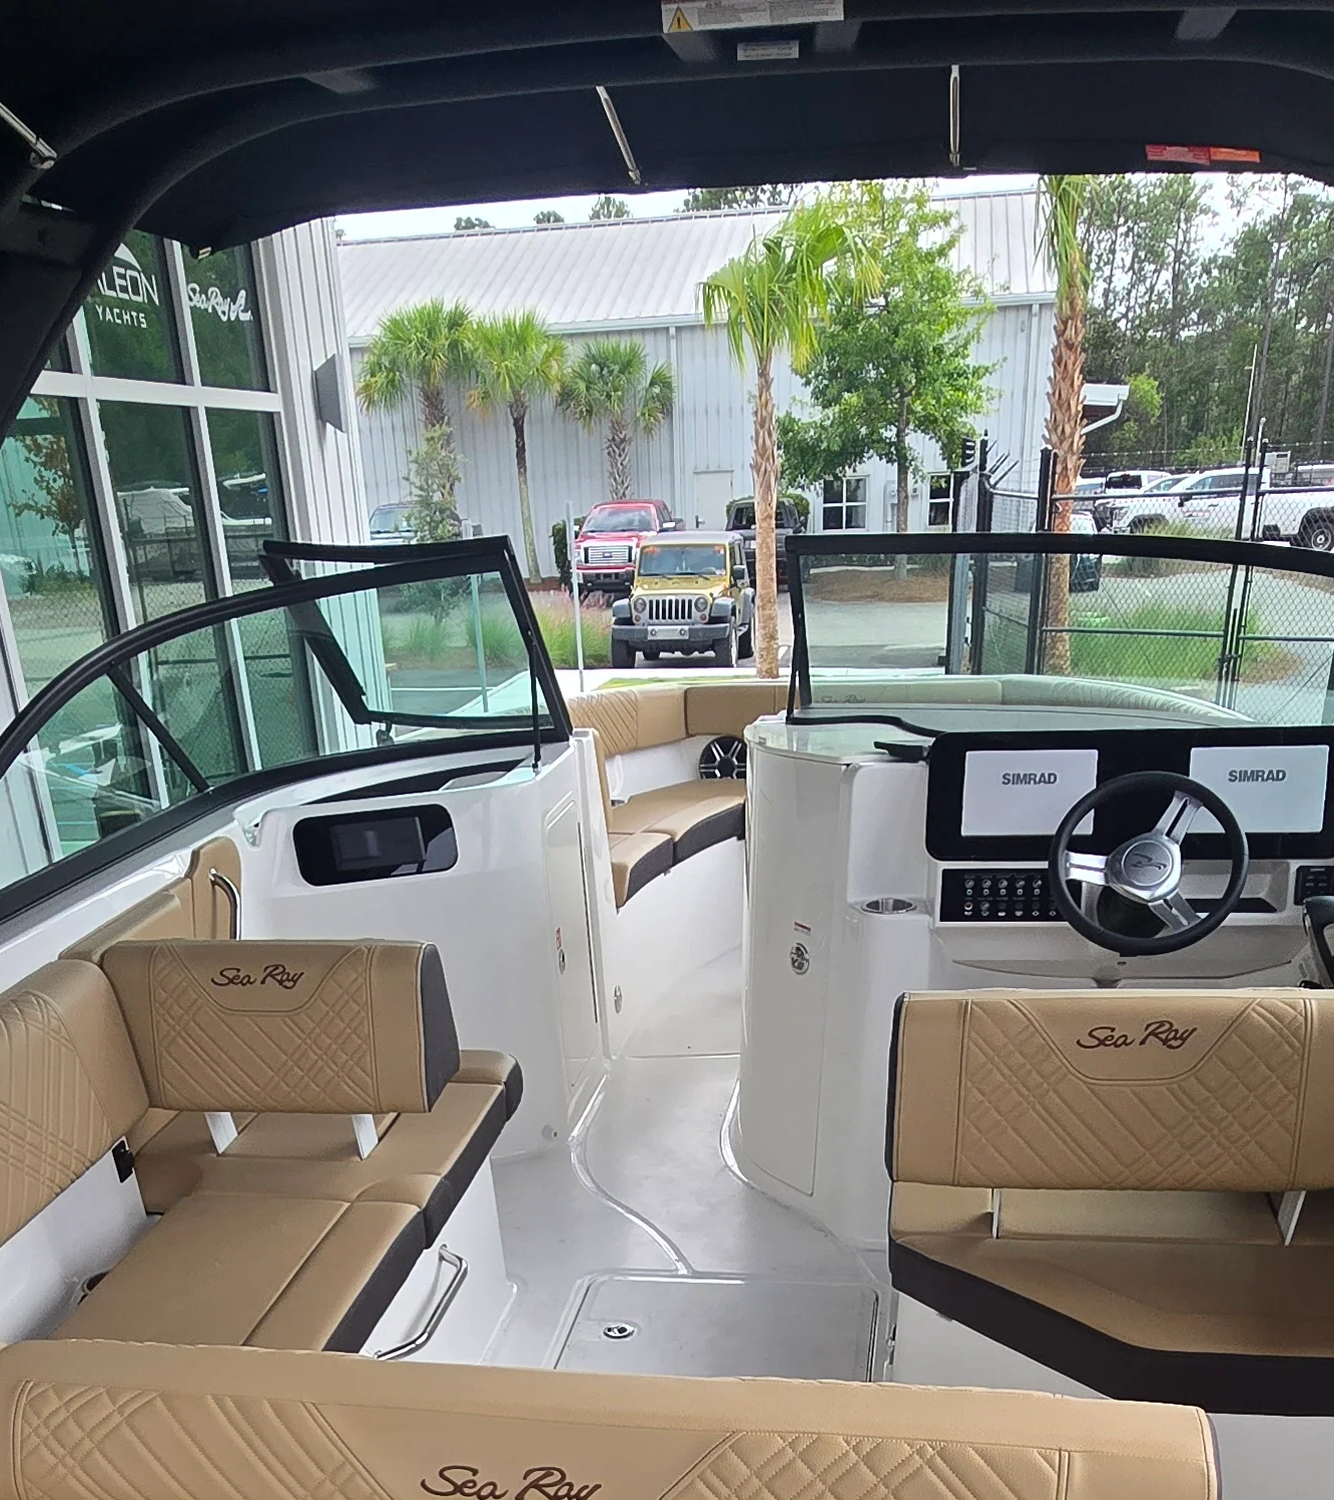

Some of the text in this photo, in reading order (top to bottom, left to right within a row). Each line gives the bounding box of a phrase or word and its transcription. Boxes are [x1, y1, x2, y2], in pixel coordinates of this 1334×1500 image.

[95, 304, 147, 329] YACHTS
[1001, 772, 1058, 786] SIMRAD
[1227, 769, 1287, 783] SIMRAD
[210, 963, 305, 990] Sea Ray
[1075, 1019, 1198, 1050] Sea Ray
[420, 1465, 509, 1500] Sea
